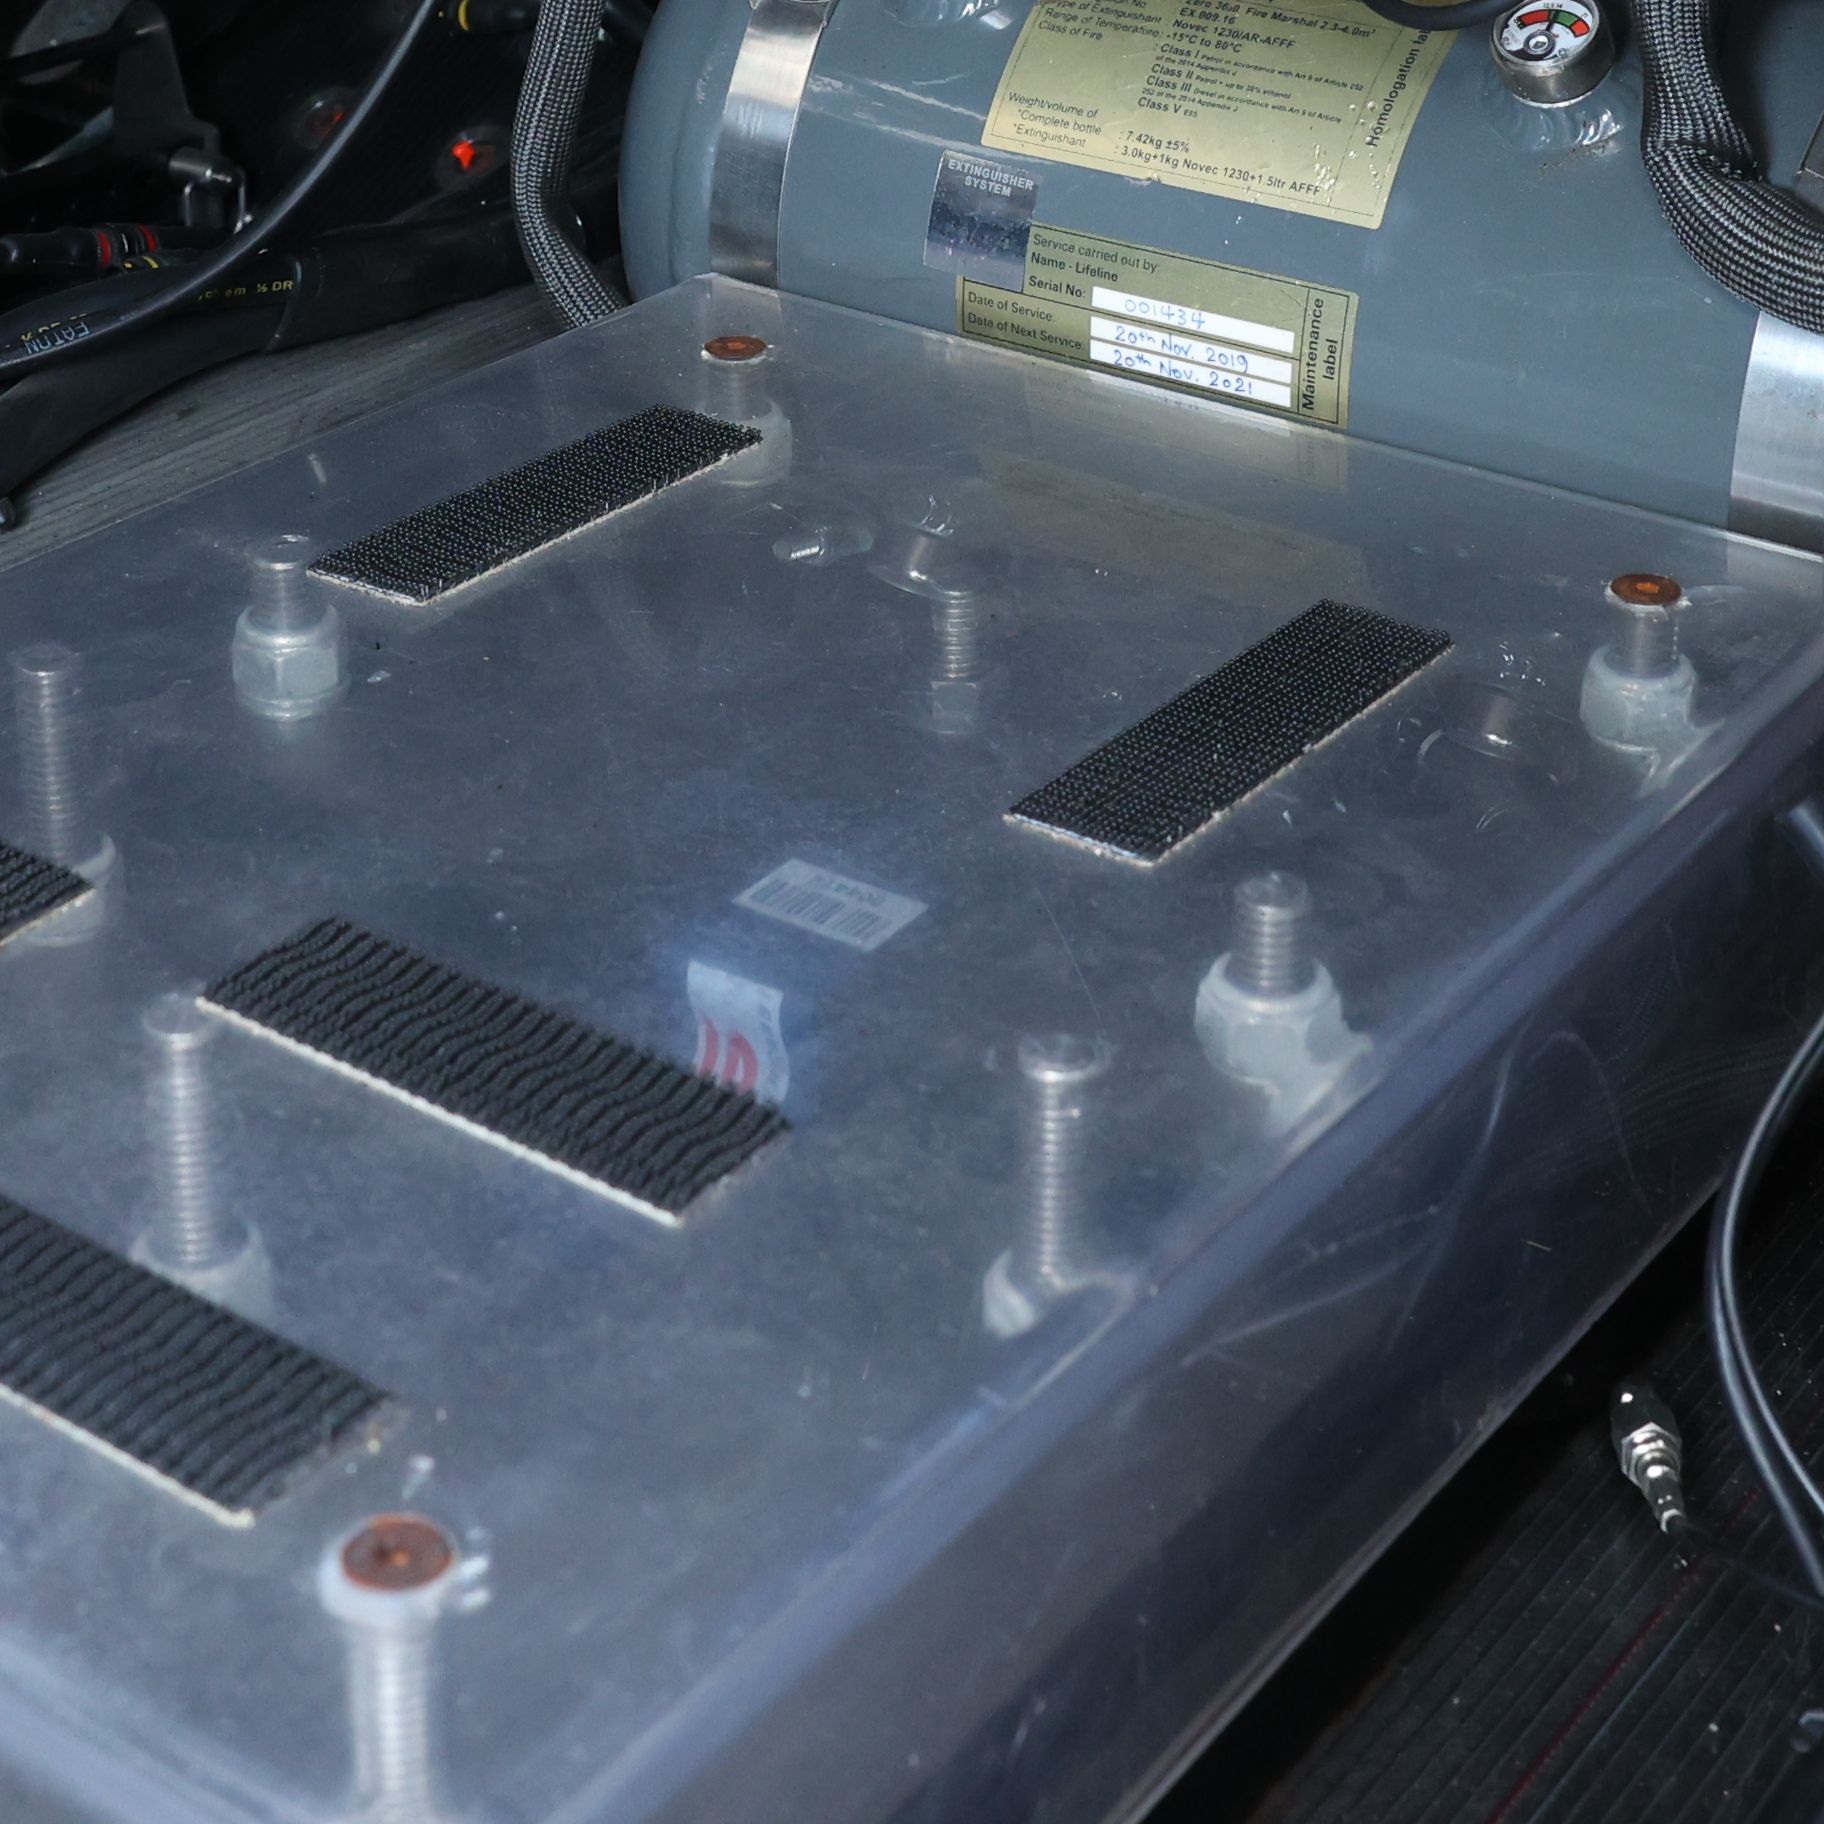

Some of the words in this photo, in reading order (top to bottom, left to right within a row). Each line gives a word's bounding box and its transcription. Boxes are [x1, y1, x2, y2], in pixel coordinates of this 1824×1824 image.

[1179, 7, 1195, 18] EX
[1245, 7, 1268, 18] Fire
[1271, 11, 1318, 27] Marshal
[1039, 20, 1067, 35] Class
[1069, 27, 1081, 36] of
[1082, 29, 1103, 40] Fire
[1045, 7, 1078, 22] Range
[1081, 15, 1094, 25] of
[1199, 37, 1212, 47] to
[1160, 43, 1192, 57] Class
[1146, 75, 1177, 90] Class
[1151, 63, 1182, 78] Class
[1009, 92, 1084, 117] Weight/volume
[1086, 109, 1099, 119] of
[1137, 96, 1169, 112] Class
[1173, 104, 1181, 114] V
[1366, 48, 1420, 147] Homologation
[1072, 122, 1102, 136] bottle
[1126, 130, 1163, 150] 7.42kg
[947, 159, 1034, 191] EXTINGUISHER
[964, 175, 1012, 197] SYSTEM
[1182, 160, 1219, 176] Novec
[1288, 181, 1323, 196] AFFF
[1033, 233, 1076, 254] Service
[1078, 244, 1118, 263] carried
[1120, 255, 1140, 268] out
[1031, 251, 1066, 271] Name
[1075, 261, 1119, 283] Lifeline
[1029, 276, 1063, 294] Serial
[968, 291, 995, 308] Date
[996, 300, 1008, 311] of
[1124, 297, 1206, 330] 001434
[25, 321, 92, 355] EATON
[968, 312, 994, 328] Date
[996, 320, 1008, 332] of
[1010, 323, 1037, 340] Next
[1114, 326, 1156, 345] 20th
[1206, 346, 1249, 373] 2019
[1302, 297, 1325, 411] Maintenance
[1322, 338, 1339, 381] label
[1113, 349, 1151, 367] 20th
[1209, 371, 1253, 394] 2021
